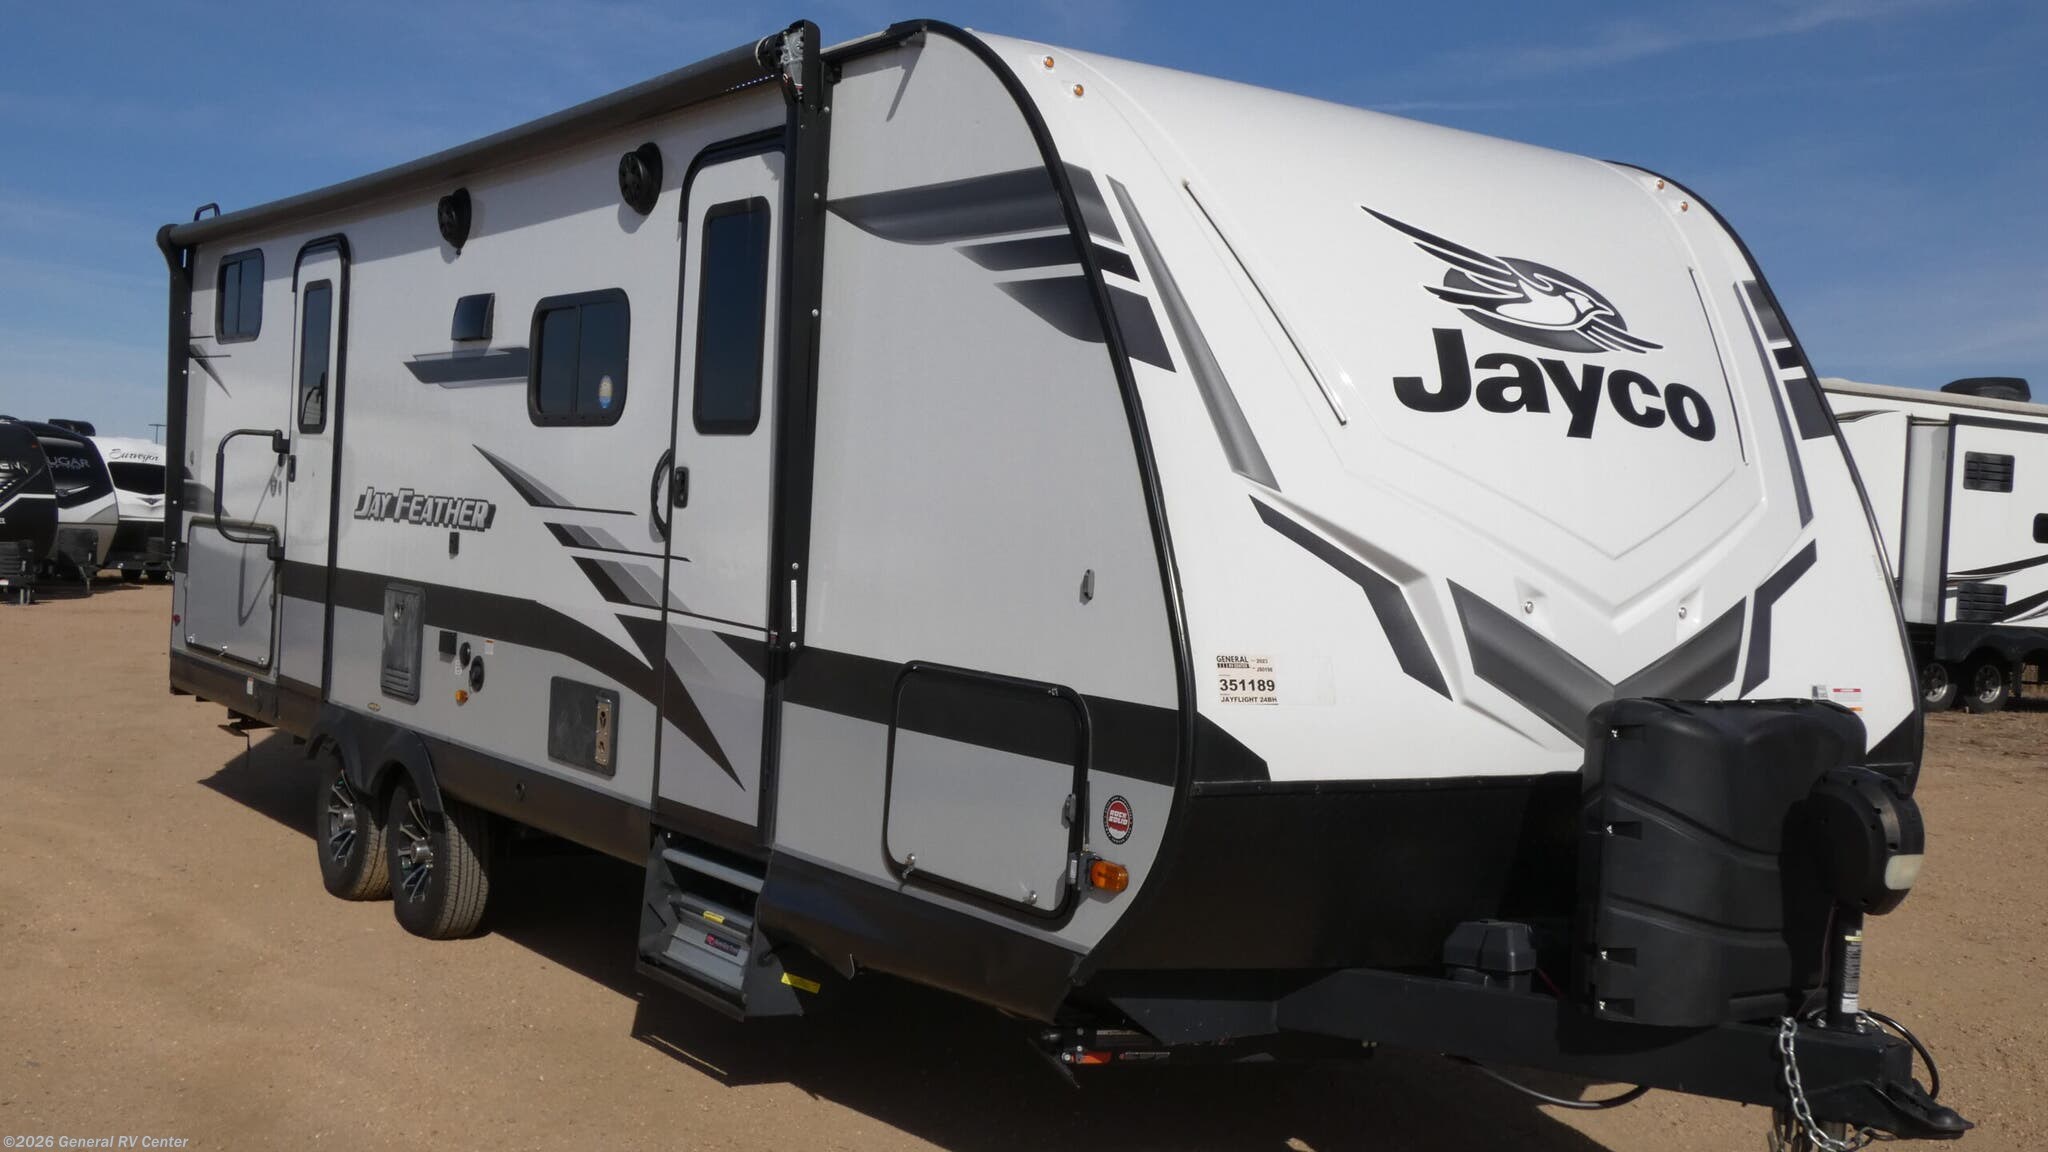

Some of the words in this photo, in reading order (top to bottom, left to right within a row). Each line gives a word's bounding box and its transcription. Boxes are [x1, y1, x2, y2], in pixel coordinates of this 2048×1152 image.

[1393, 328, 1716, 442] Jayco
[111, 449, 160, 462] Surveyor
[394, 488, 497, 532] FEATHER
[1220, 679, 1275, 691] 351189
